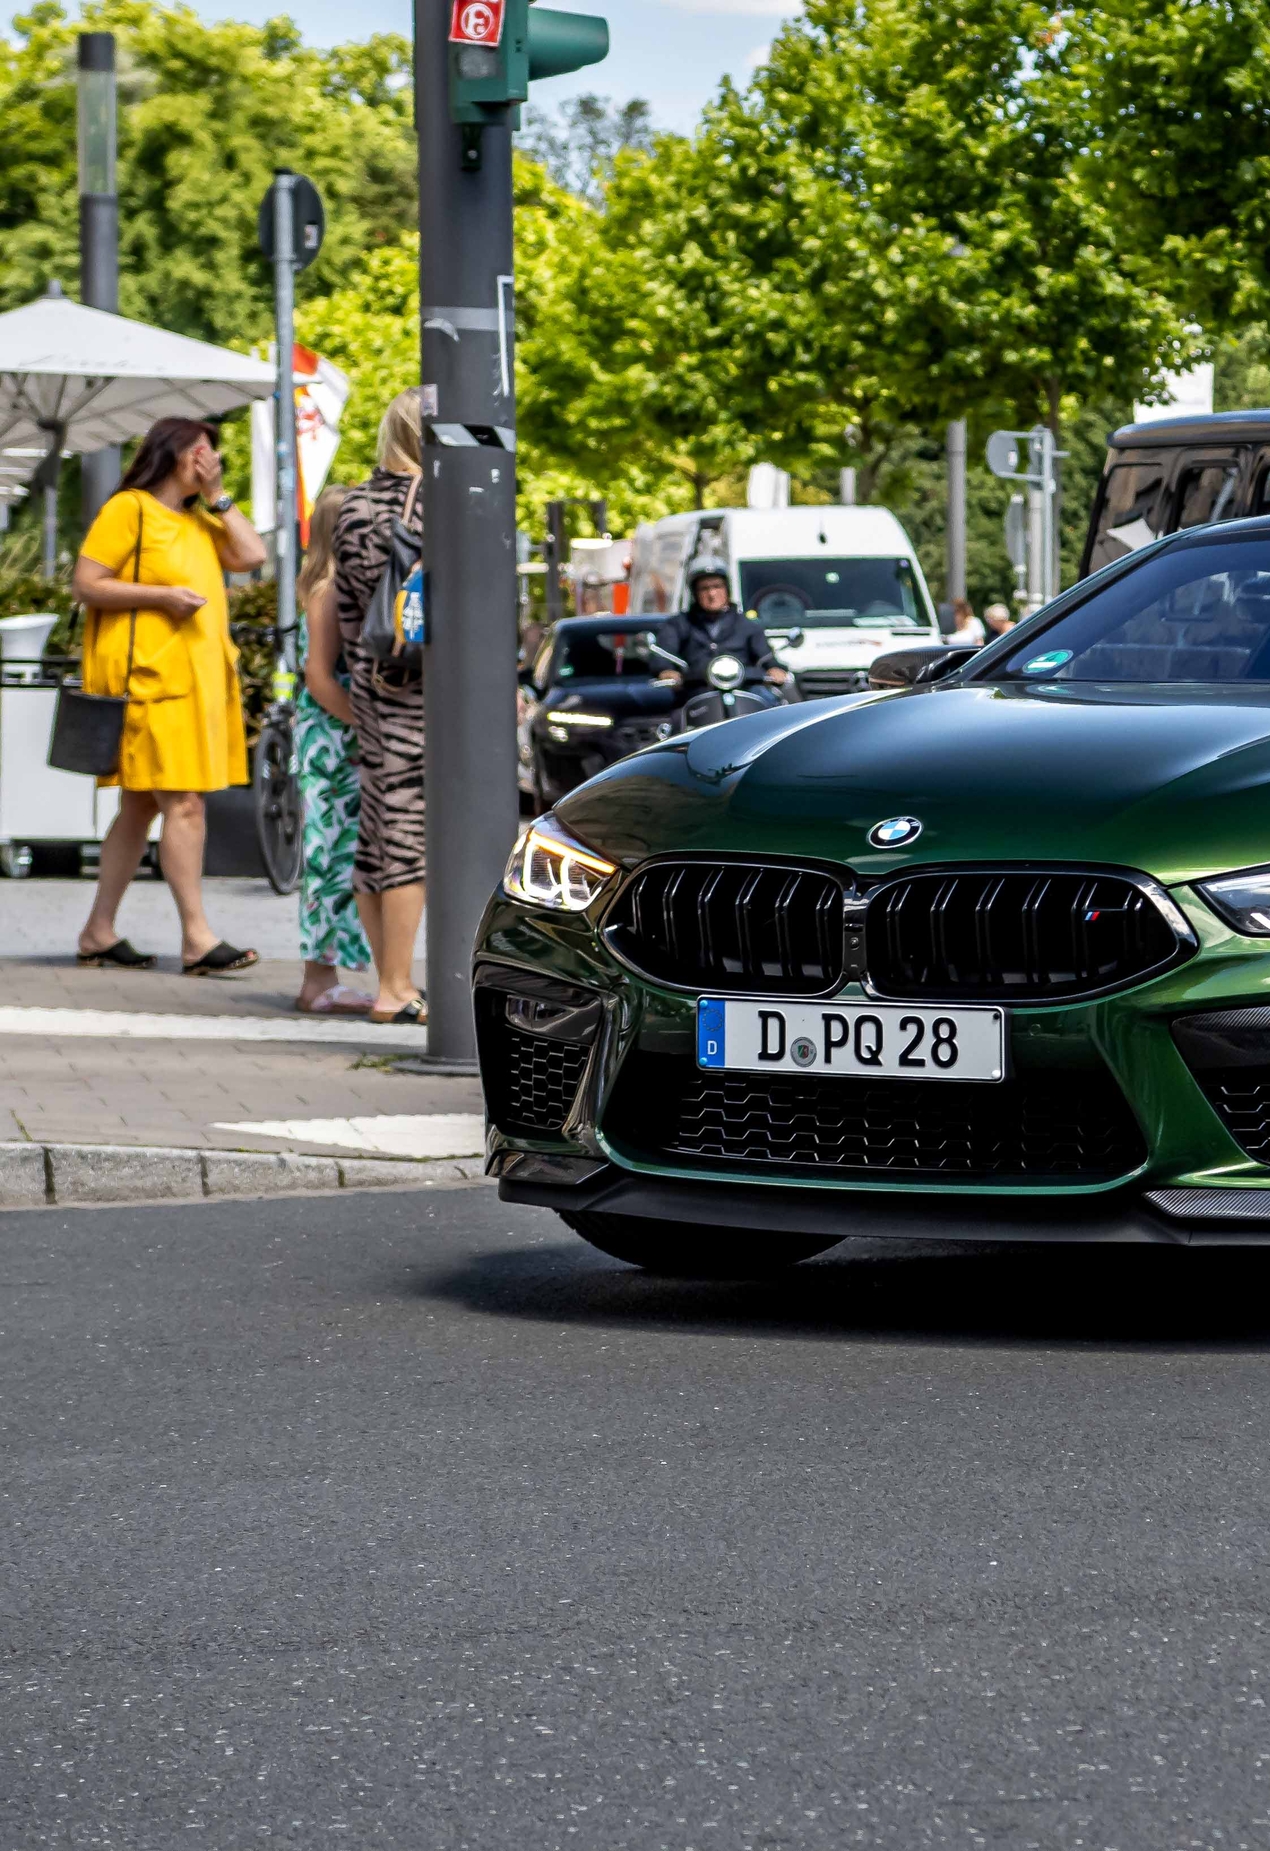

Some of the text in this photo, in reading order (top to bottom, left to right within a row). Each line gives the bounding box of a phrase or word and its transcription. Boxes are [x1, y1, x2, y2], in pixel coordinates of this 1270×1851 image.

[707, 1040, 717, 1055] D
[757, 1009, 787, 1061] D
[821, 1012, 884, 1067] PQ
[898, 1015, 959, 1069] 28
